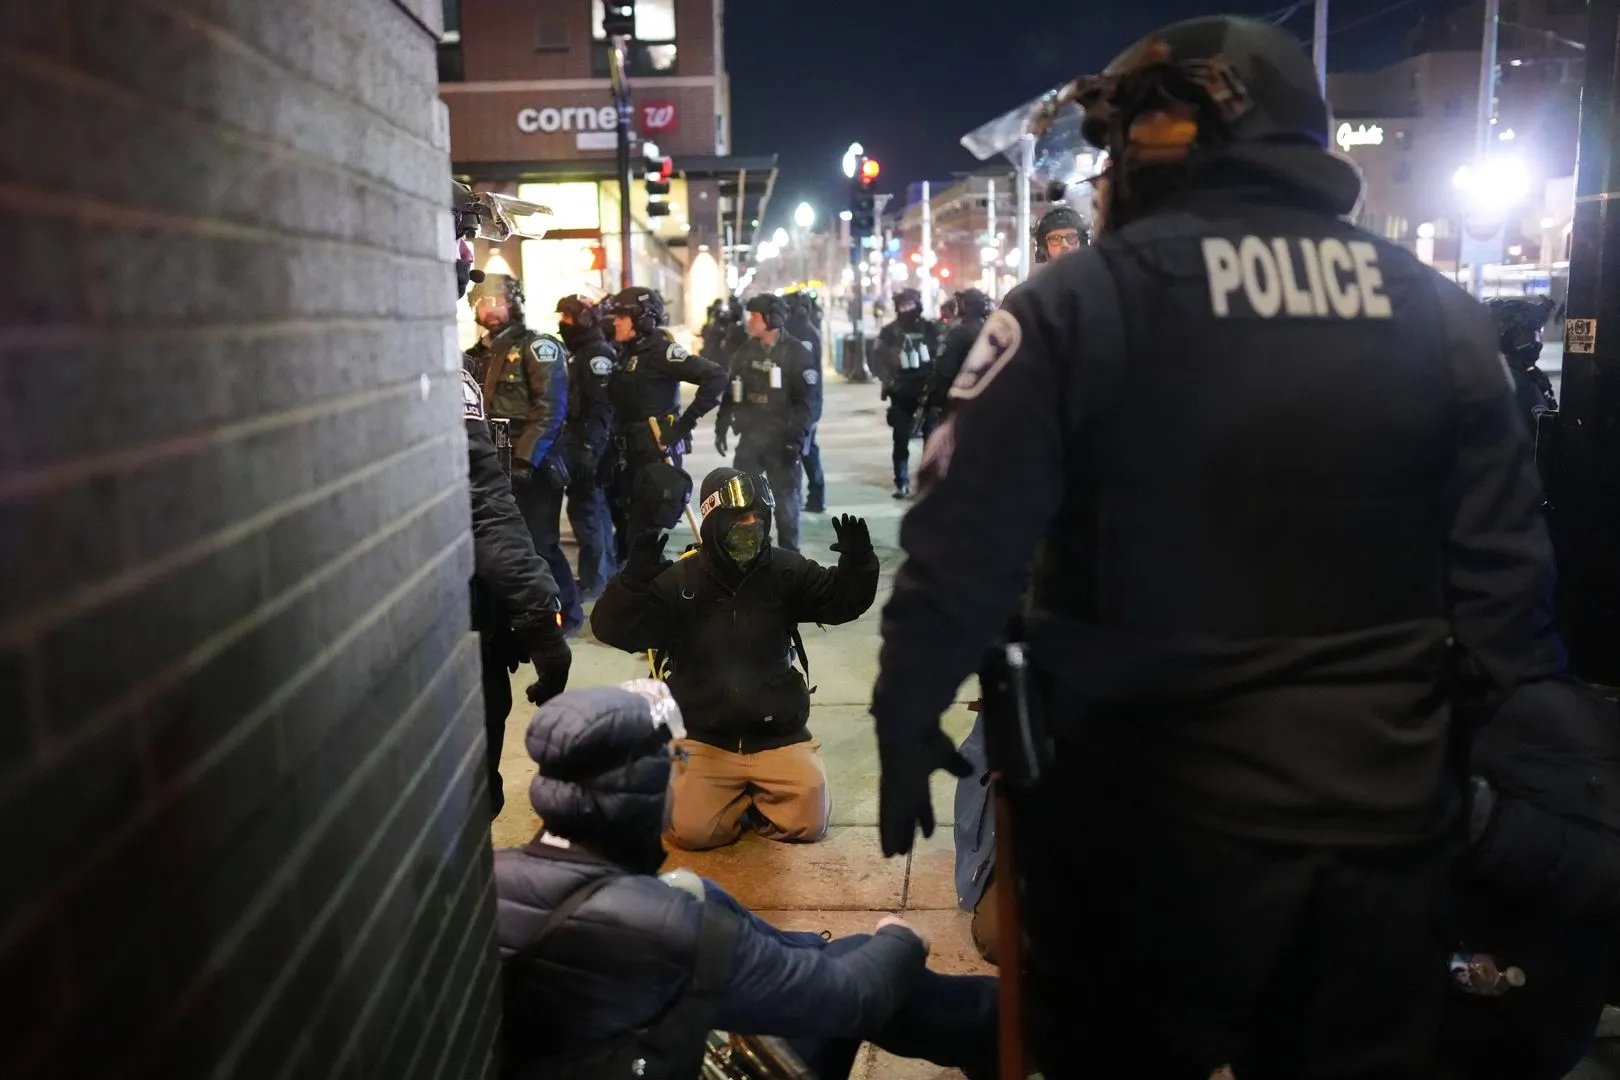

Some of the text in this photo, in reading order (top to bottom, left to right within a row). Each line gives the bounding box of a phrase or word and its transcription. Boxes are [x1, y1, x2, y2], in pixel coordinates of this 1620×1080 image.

[517, 106, 634, 133] corne
[1202, 235, 1393, 319] POLICE
[464, 405, 480, 416] LICE
